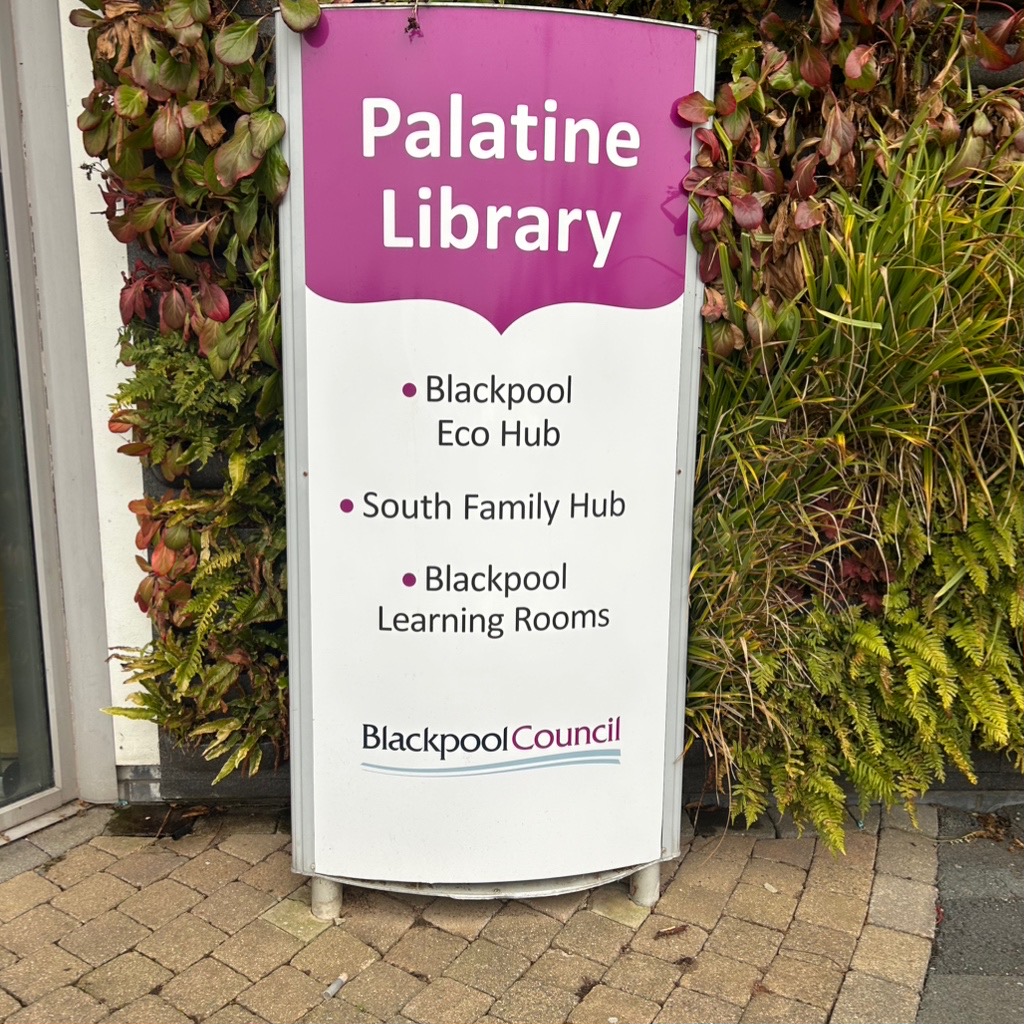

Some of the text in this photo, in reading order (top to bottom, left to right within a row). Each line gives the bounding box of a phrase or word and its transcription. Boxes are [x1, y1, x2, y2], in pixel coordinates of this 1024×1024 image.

[361, 93, 641, 168] Palatine
[382, 185, 621, 269] Library
[426, 374, 573, 410] Blackpool
[438, 418, 561, 447] Eco Hub
[362, 490, 626, 525] South Family Hub
[425, 562, 568, 598] Blackpool
[377, 606, 610, 639] Learning Rooms
